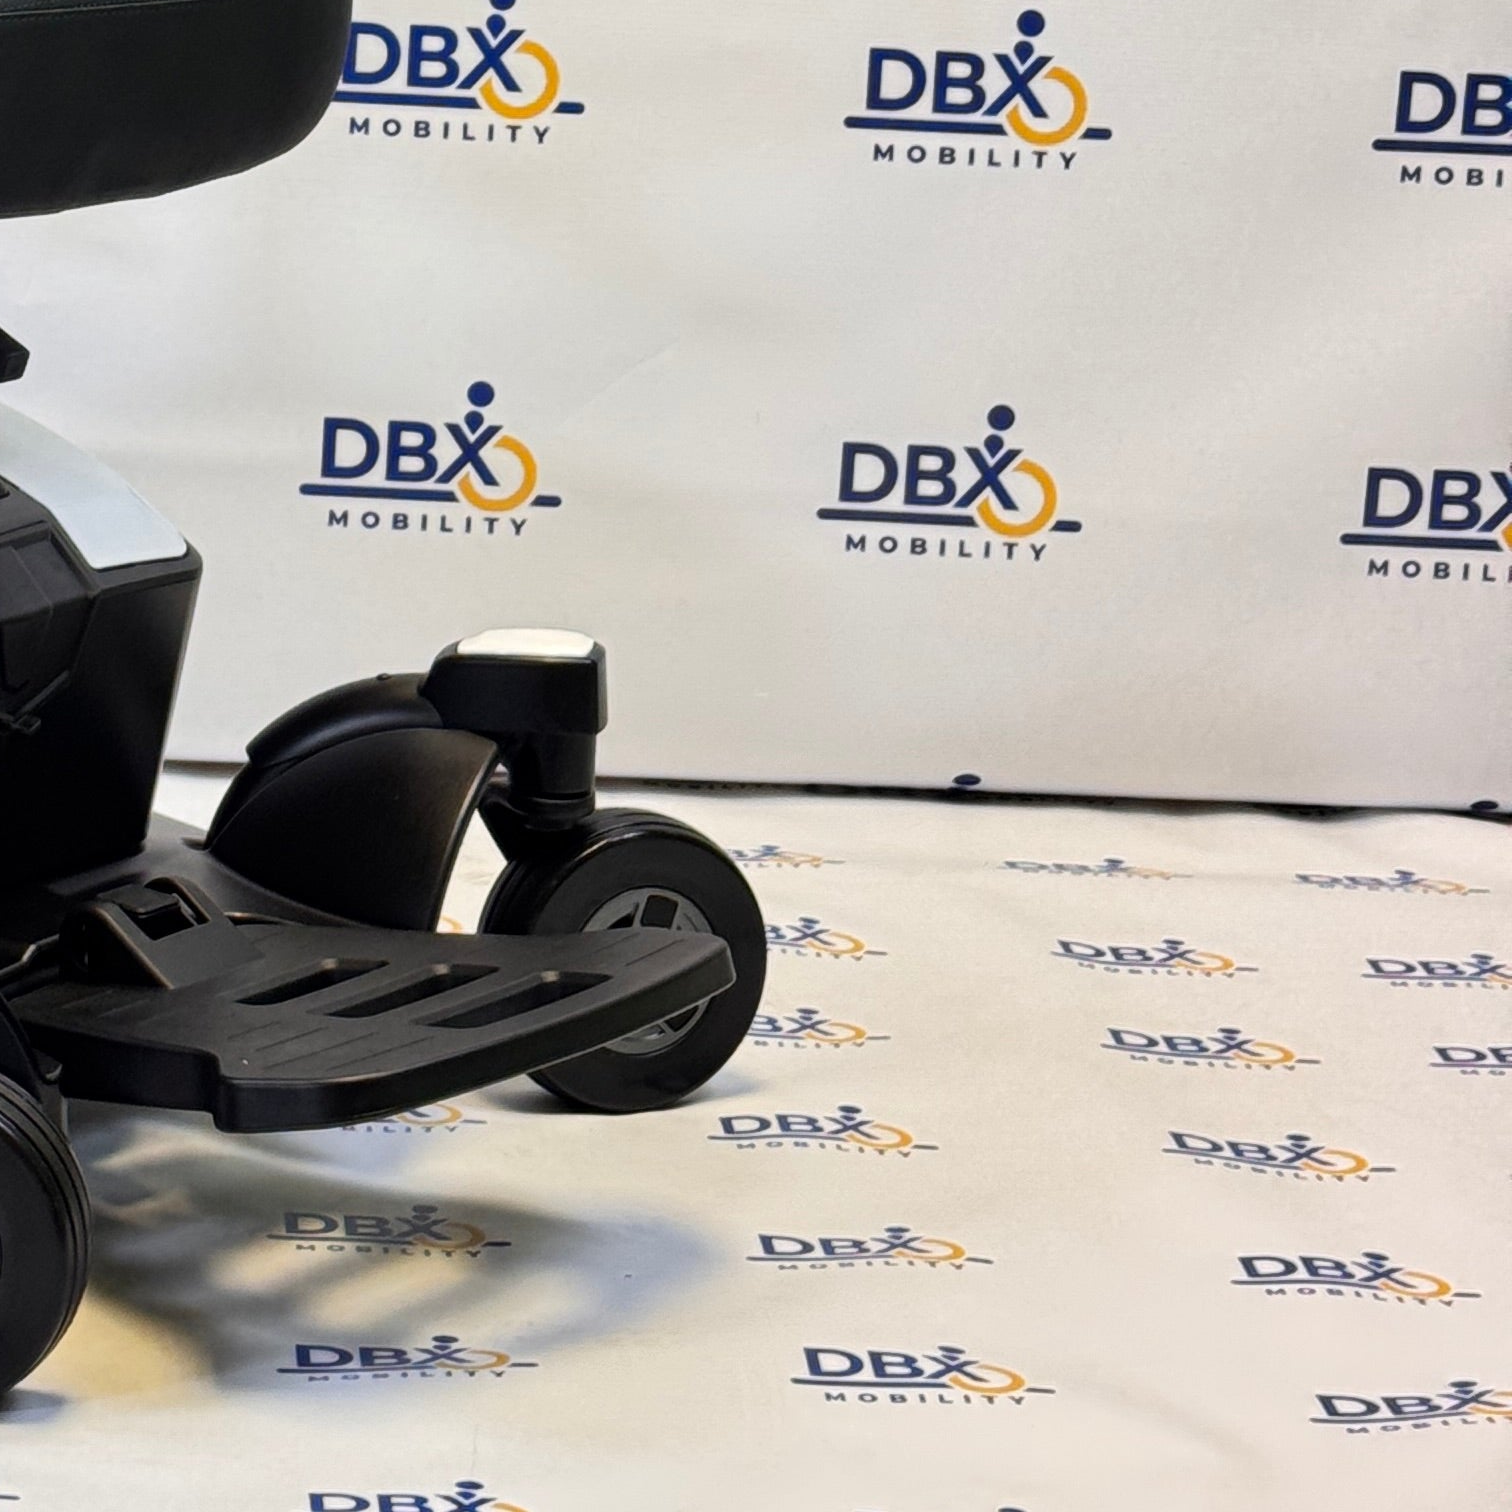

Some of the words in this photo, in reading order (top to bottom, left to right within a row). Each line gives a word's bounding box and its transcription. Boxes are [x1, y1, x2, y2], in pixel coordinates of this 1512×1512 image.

[344, 23, 525, 92] DBX
[866, 48, 1054, 119] DBX
[1395, 71, 1512, 136] DB
[349, 117, 549, 144] MOBILITY
[874, 144, 1076, 169] MOBILITY
[1400, 166, 1503, 187] MOBI
[321, 417, 503, 486] DBX
[839, 442, 1022, 511] DBX
[328, 510, 526, 535] MOBILITY
[846, 535, 1046, 561] MOBILITY
[1058, 940, 1204, 965] DBX
[751, 1015, 837, 1036] BX
[1107, 1028, 1264, 1056] DBX
[719, 1114, 881, 1139] DBX
[1168, 1130, 1337, 1168] DBX
[285, 1212, 452, 1241] DBX
[757, 1234, 931, 1256] DBX
[1238, 1255, 1420, 1288] DBX
[295, 1343, 478, 1368] DBX
[803, 1346, 986, 1382] DBX
[824, 1391, 1026, 1406] MOBILITY
[1315, 1389, 1507, 1416] DBX
